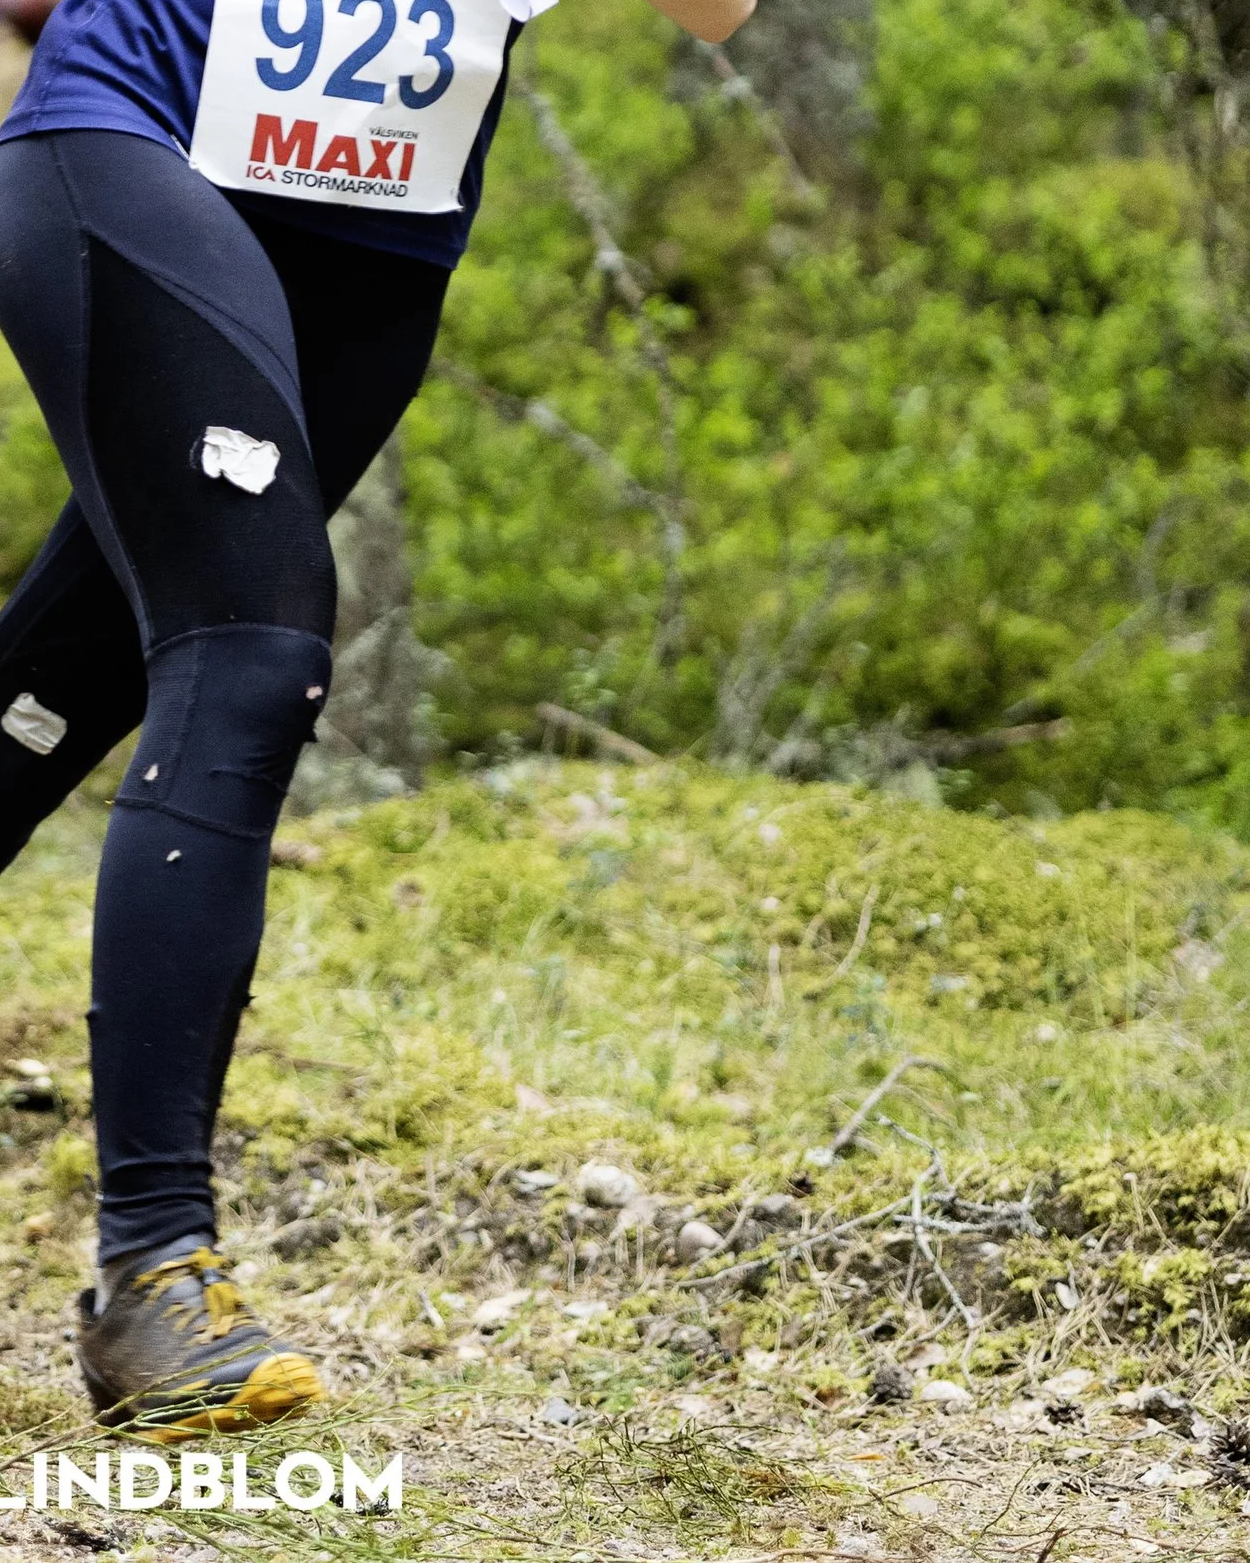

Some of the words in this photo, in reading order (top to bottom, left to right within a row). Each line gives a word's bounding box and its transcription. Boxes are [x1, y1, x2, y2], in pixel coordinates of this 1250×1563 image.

[249, 113, 417, 182] MAXI
[370, 126, 419, 140] VÄLSVIKEN
[246, 165, 276, 182] ICA
[281, 170, 408, 198] STORMARKNAD
